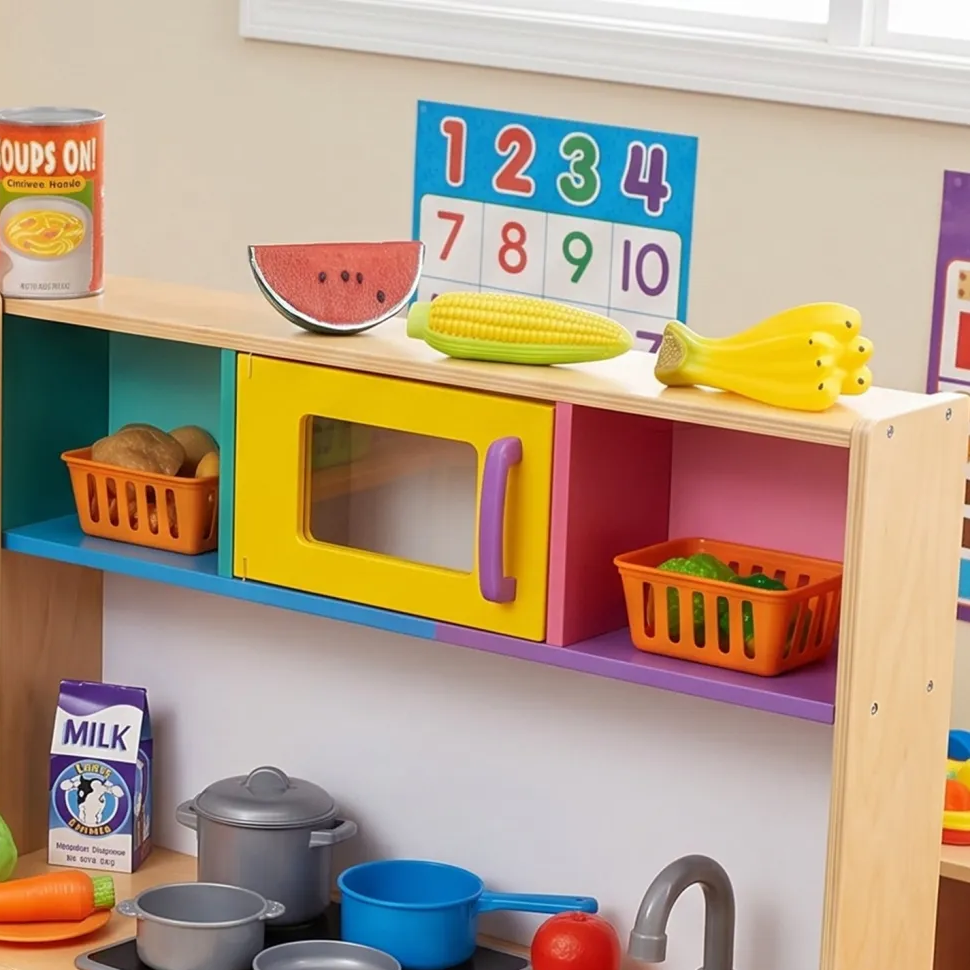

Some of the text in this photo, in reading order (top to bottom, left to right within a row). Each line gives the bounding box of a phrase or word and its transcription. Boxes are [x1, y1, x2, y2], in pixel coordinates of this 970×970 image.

[63, 137, 97, 175] ON!
[441, 117, 670, 216] 1 2 3 4
[437, 210, 670, 297] 7 8 9 10
[62, 718, 131, 751] MILK
